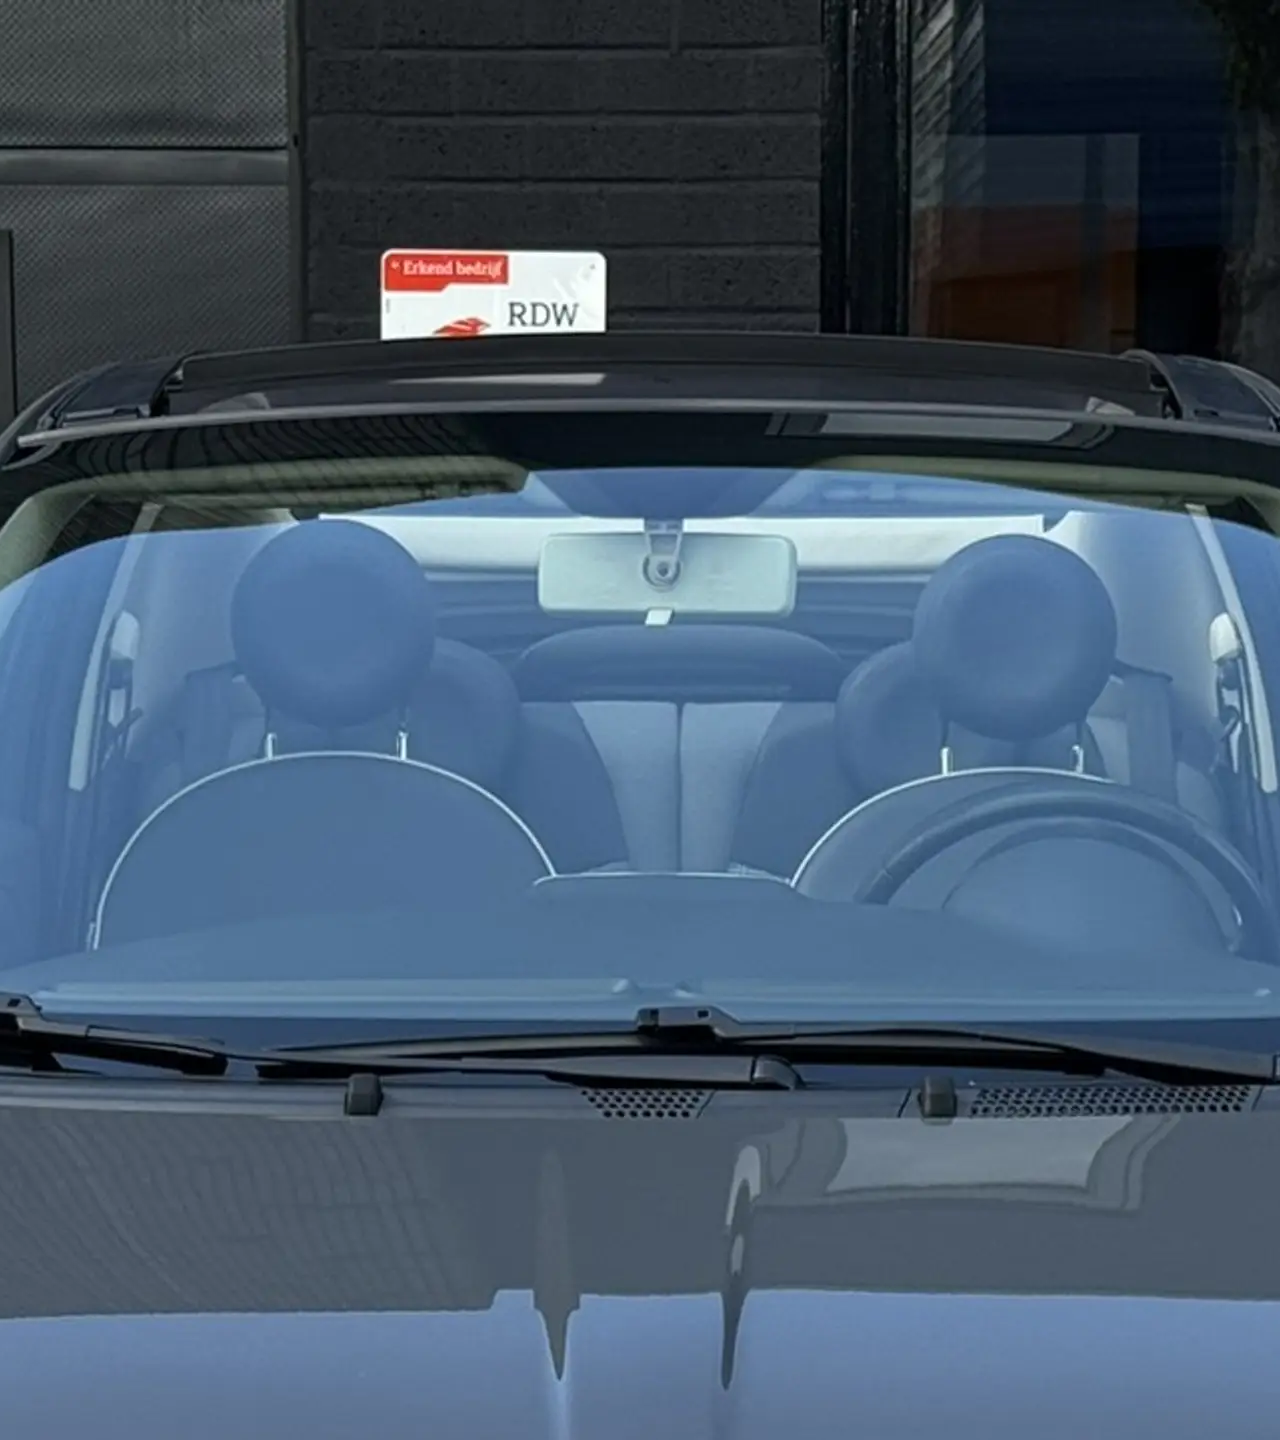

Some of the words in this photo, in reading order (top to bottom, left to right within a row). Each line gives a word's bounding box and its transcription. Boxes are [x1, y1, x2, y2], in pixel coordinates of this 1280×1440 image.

[403, 260, 453, 276] Erkend
[456, 260, 503, 279] bedrijf
[508, 302, 579, 327] RDW
